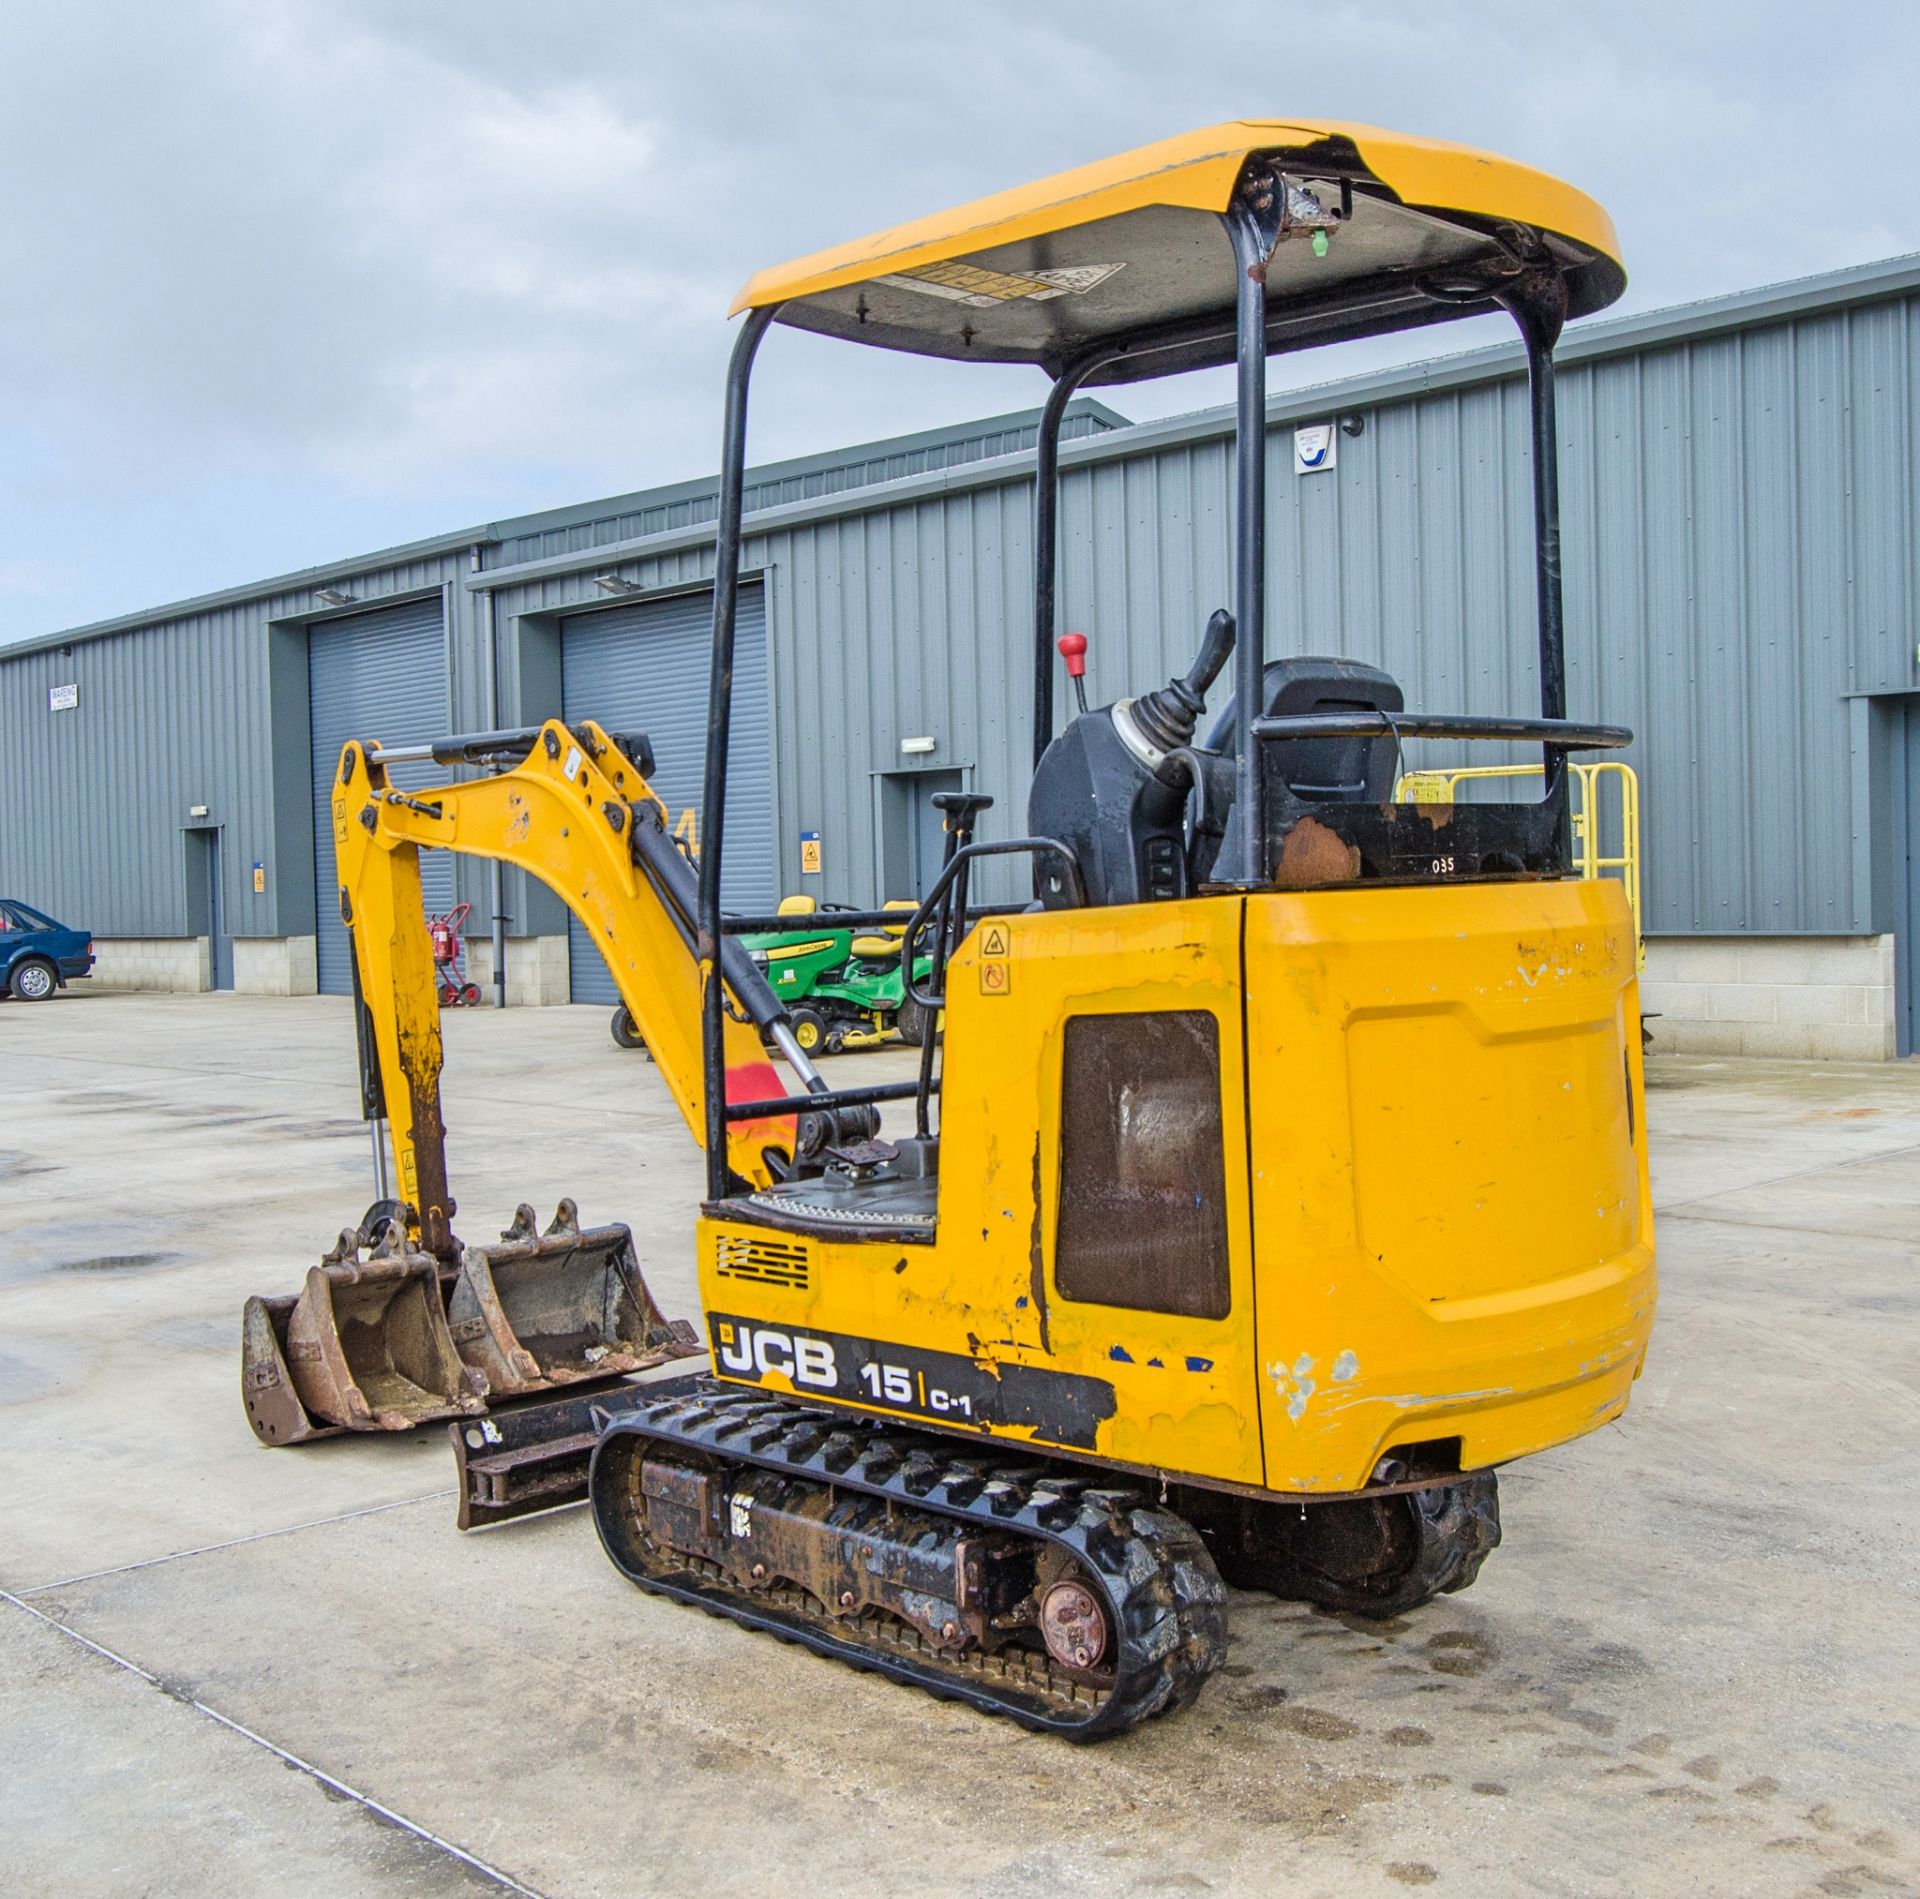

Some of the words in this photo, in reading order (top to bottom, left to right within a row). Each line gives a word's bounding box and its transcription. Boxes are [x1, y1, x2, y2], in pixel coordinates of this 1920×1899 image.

[1432, 857, 1454, 873] 035
[721, 1326, 838, 1388] JCB
[860, 1362, 912, 1403] 15
